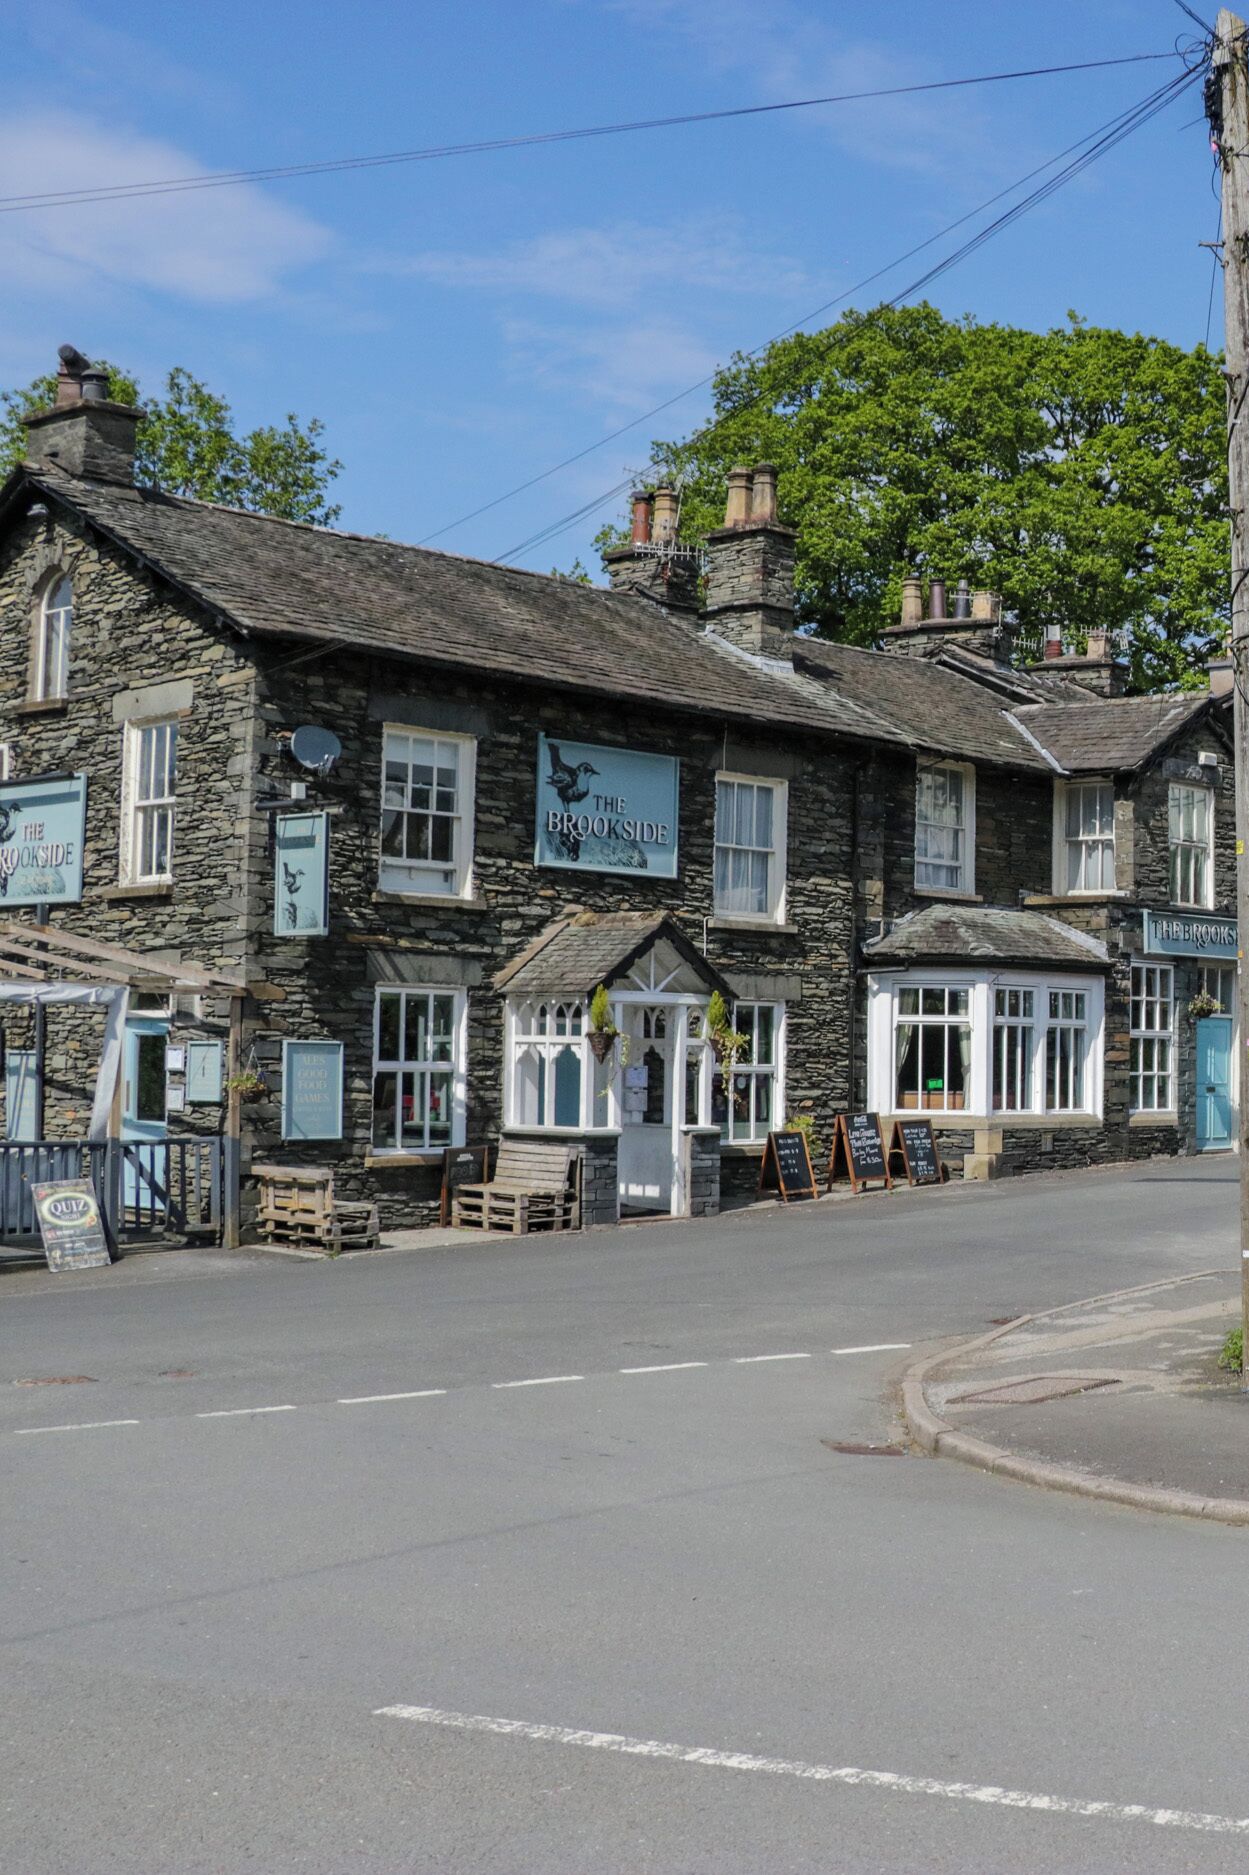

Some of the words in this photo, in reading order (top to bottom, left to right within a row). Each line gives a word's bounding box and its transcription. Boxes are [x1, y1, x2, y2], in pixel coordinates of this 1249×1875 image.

[593, 794, 627, 814] THE
[23, 821, 45, 841] THE
[547, 810, 669, 845] BROOKSIDE
[1152, 920, 1181, 941] THE
[295, 1093, 330, 1104] GAMES
[51, 1200, 88, 1215] QUIZ
